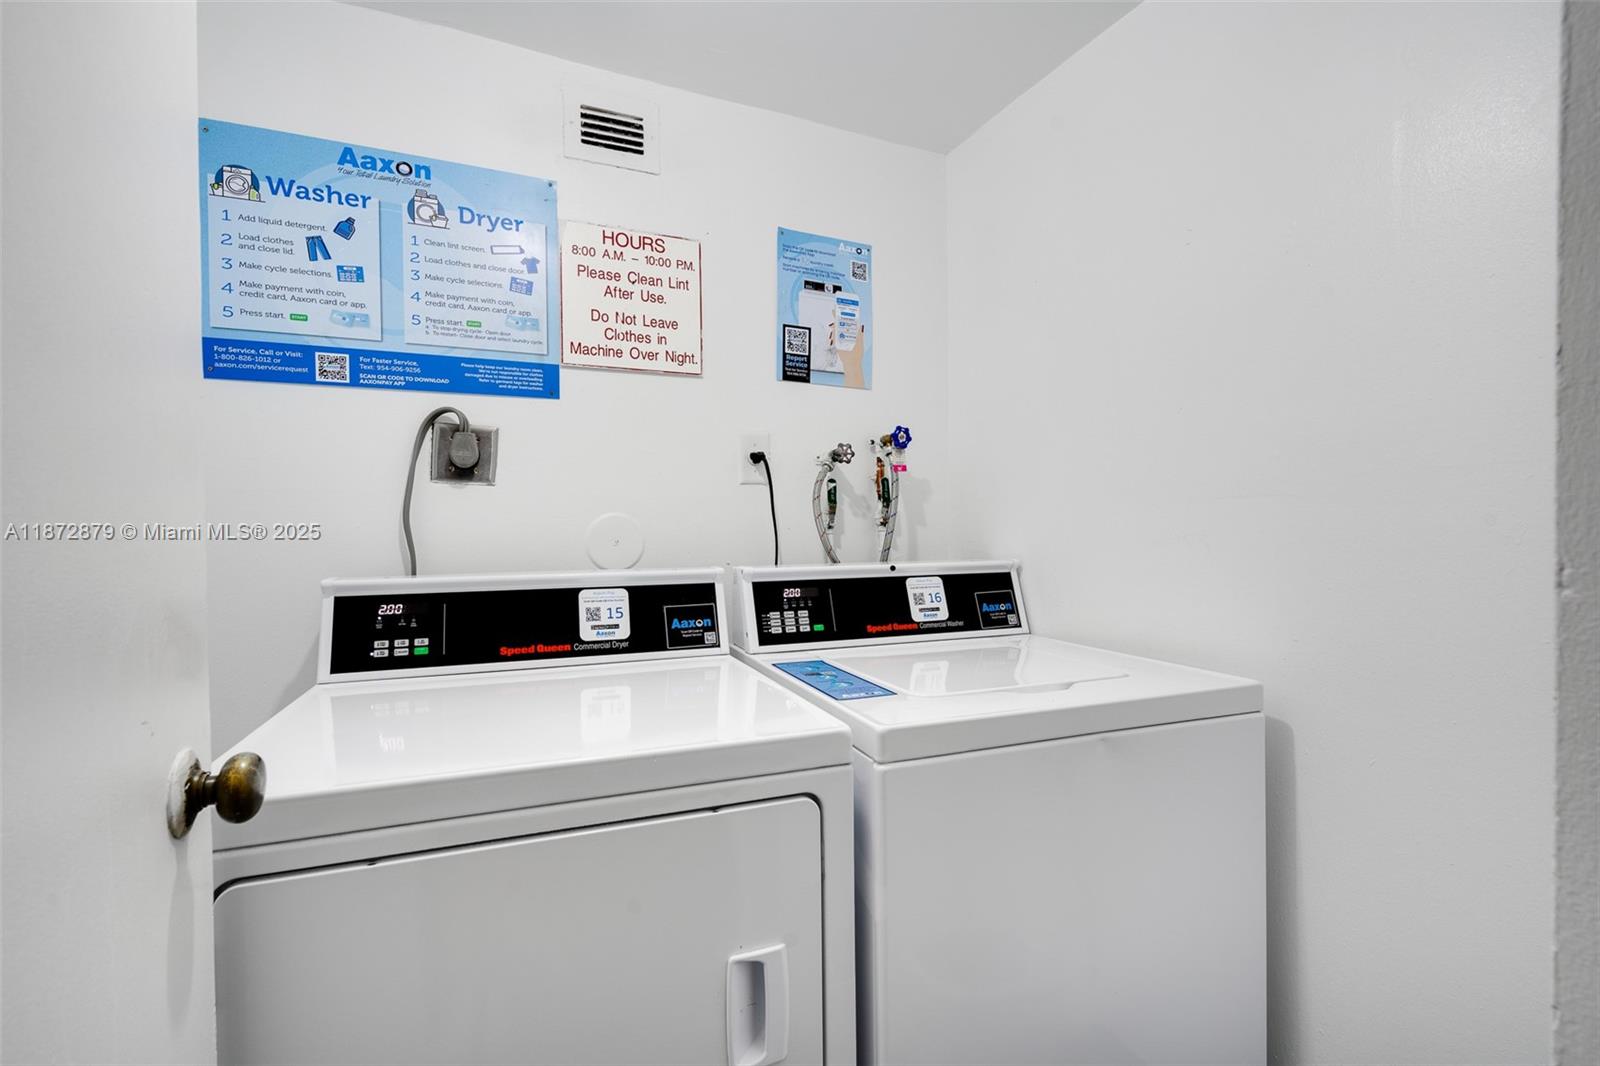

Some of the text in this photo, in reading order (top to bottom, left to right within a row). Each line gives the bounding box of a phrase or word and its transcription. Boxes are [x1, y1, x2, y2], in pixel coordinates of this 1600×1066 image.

[337, 147, 431, 180] Aaxon
[337, 167, 431, 188] Your Total Laundry Solution
[265, 176, 372, 208] Washer
[221, 209, 327, 232] 1 Add liquid detergent.
[457, 206, 524, 232] Dryer
[220, 233, 294, 246] 2 Load clothes
[411, 235, 486, 253] 1 Clean lint screen.
[602, 229, 666, 254] HOURS
[238, 243, 295, 255] and close lid.
[410, 252, 420, 264] 2
[424, 256, 443, 265] Load
[445, 258, 471, 268] clothes
[473, 262, 487, 271] and
[488, 264, 507, 273] close
[571, 244, 596, 258] 8:00
[602, 249, 626, 262] A.M.
[644, 255, 672, 268] 10:00
[676, 260, 696, 272] P.M.
[221, 258, 332, 278] 3 Make cycle selections.
[410, 269, 420, 281] 3
[424, 273, 445, 282] Make
[446, 276, 465, 285] cycle
[577, 264, 690, 291] Please Clean Lint
[221, 280, 346, 299] 4 Make payment with coin,
[604, 285, 667, 305] After Use.
[239, 289, 264, 299] credit
[267, 292, 288, 301] card,
[290, 295, 317, 304] Aaxon
[319, 297, 338, 306] card
[350, 301, 368, 310] app.
[410, 290, 515, 308] 4 Make payment with coin,
[425, 300, 447, 309] credit
[448, 302, 466, 311] card,
[467, 304, 491, 312] Aaxon
[492, 306, 508, 314] card
[222, 305, 285, 319] 5 Press start.
[411, 314, 421, 326] 5
[425, 316, 445, 325] Press
[591, 309, 679, 330] Do Not Leave
[604, 327, 667, 346] Clothes in
[214, 353, 272, 363] 1-800-826-1012
[259, 348, 274, 356] Call
[570, 341, 698, 367] Machine Over Night.
[786, 354, 808, 363] Report
[214, 362, 309, 373] aaxon.com/servicerequest
[372, 357, 392, 365] Faster
[785, 360, 808, 369] Service
[928, 592, 942, 603] 16
[606, 606, 624, 620] 15
[981, 602, 1012, 612] Aaxon
[671, 618, 712, 629] Aaxon
[866, 623, 892, 633] Speed
[893, 622, 918, 632] Queen
[500, 640, 630, 657] Speed Queen Commercial Dryer
